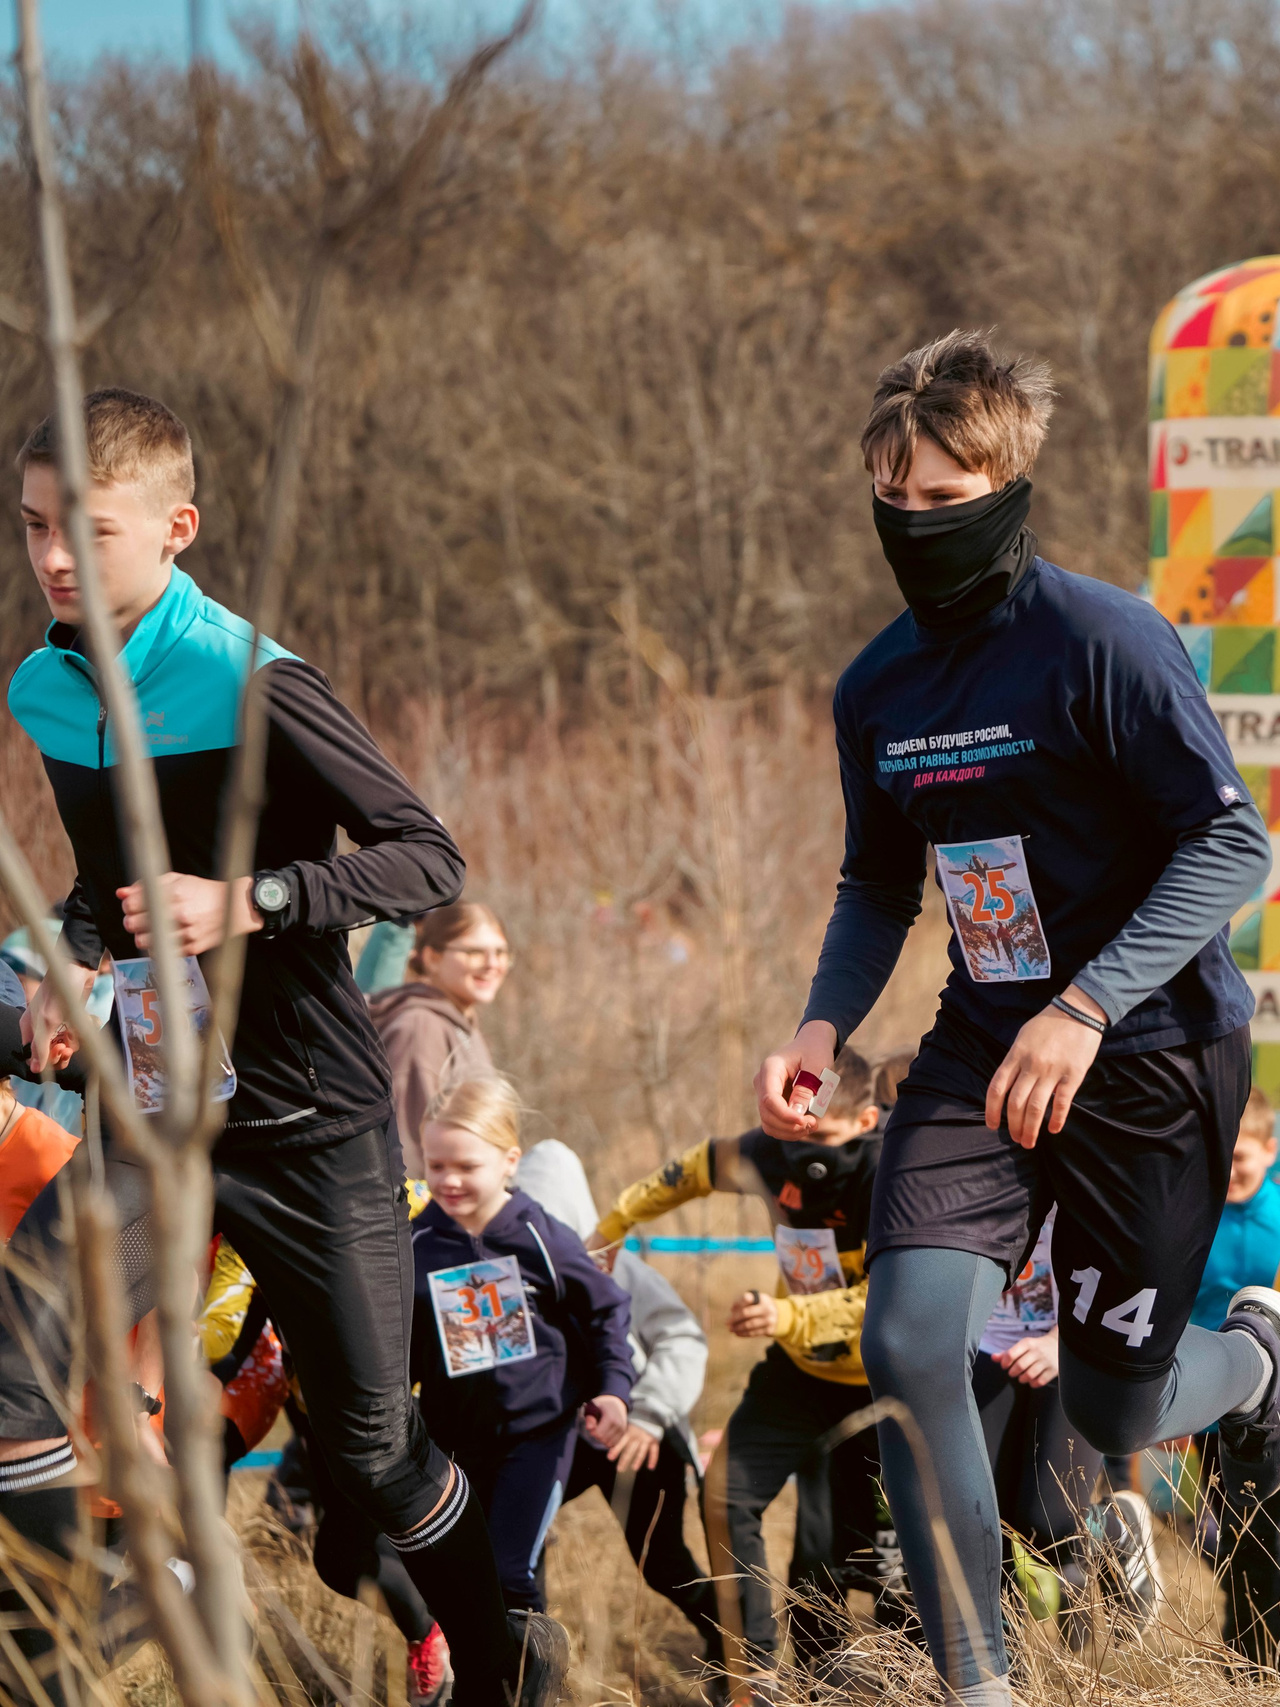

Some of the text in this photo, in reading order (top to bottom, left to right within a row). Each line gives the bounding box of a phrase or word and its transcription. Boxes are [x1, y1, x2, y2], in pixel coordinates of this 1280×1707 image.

[929, 730, 975, 750] БУДУЩЕЕ
[975, 724, 1013, 744] РОССИИ,
[919, 751, 960, 769] РАВНЫЕ
[961, 739, 1036, 764] ВОЗМОЖНОСТИ
[913, 765, 986, 789] ДЛЯ КАЖДОГО!
[961, 868, 1016, 923] 25
[790, 1246, 824, 1279] 29
[457, 1282, 503, 1324] 31
[1070, 1266, 1158, 1348] 14
